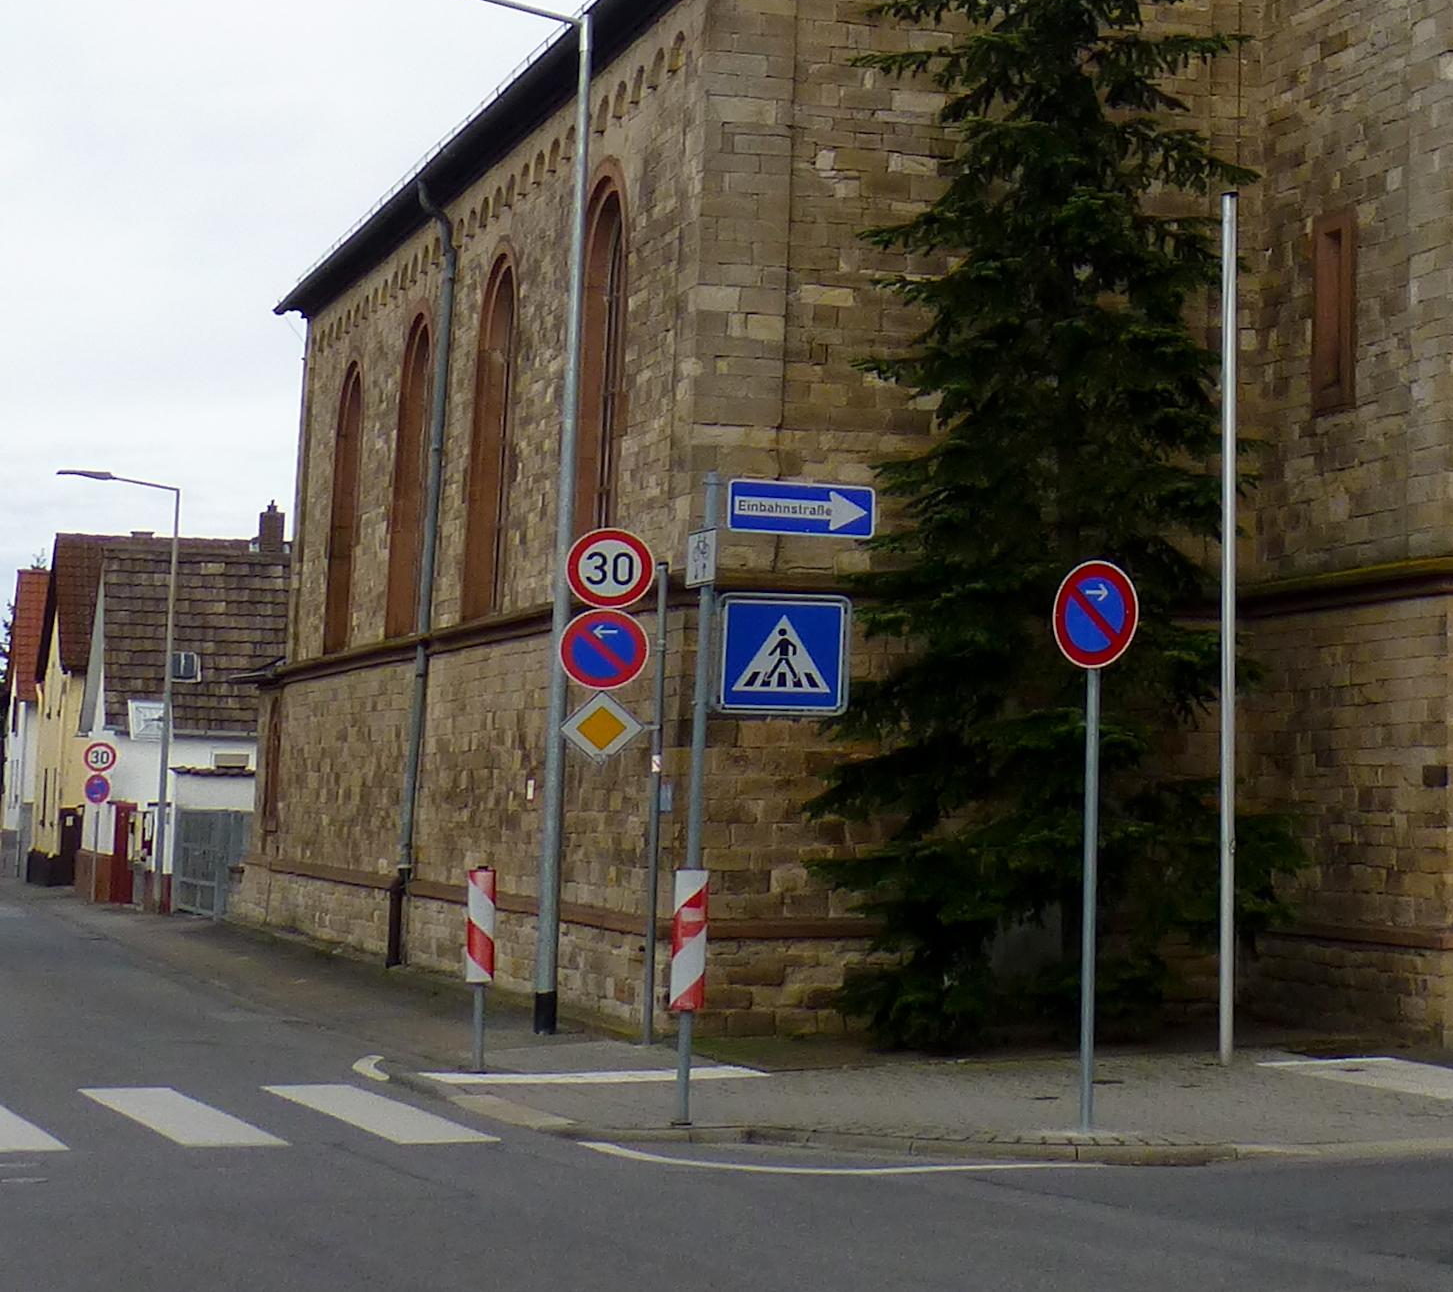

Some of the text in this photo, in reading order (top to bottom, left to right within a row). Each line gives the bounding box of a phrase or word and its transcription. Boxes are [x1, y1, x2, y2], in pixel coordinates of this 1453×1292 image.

[738, 499, 832, 516] Einbahnstraße
[586, 551, 635, 586] 30
[90, 750, 110, 764] 30
